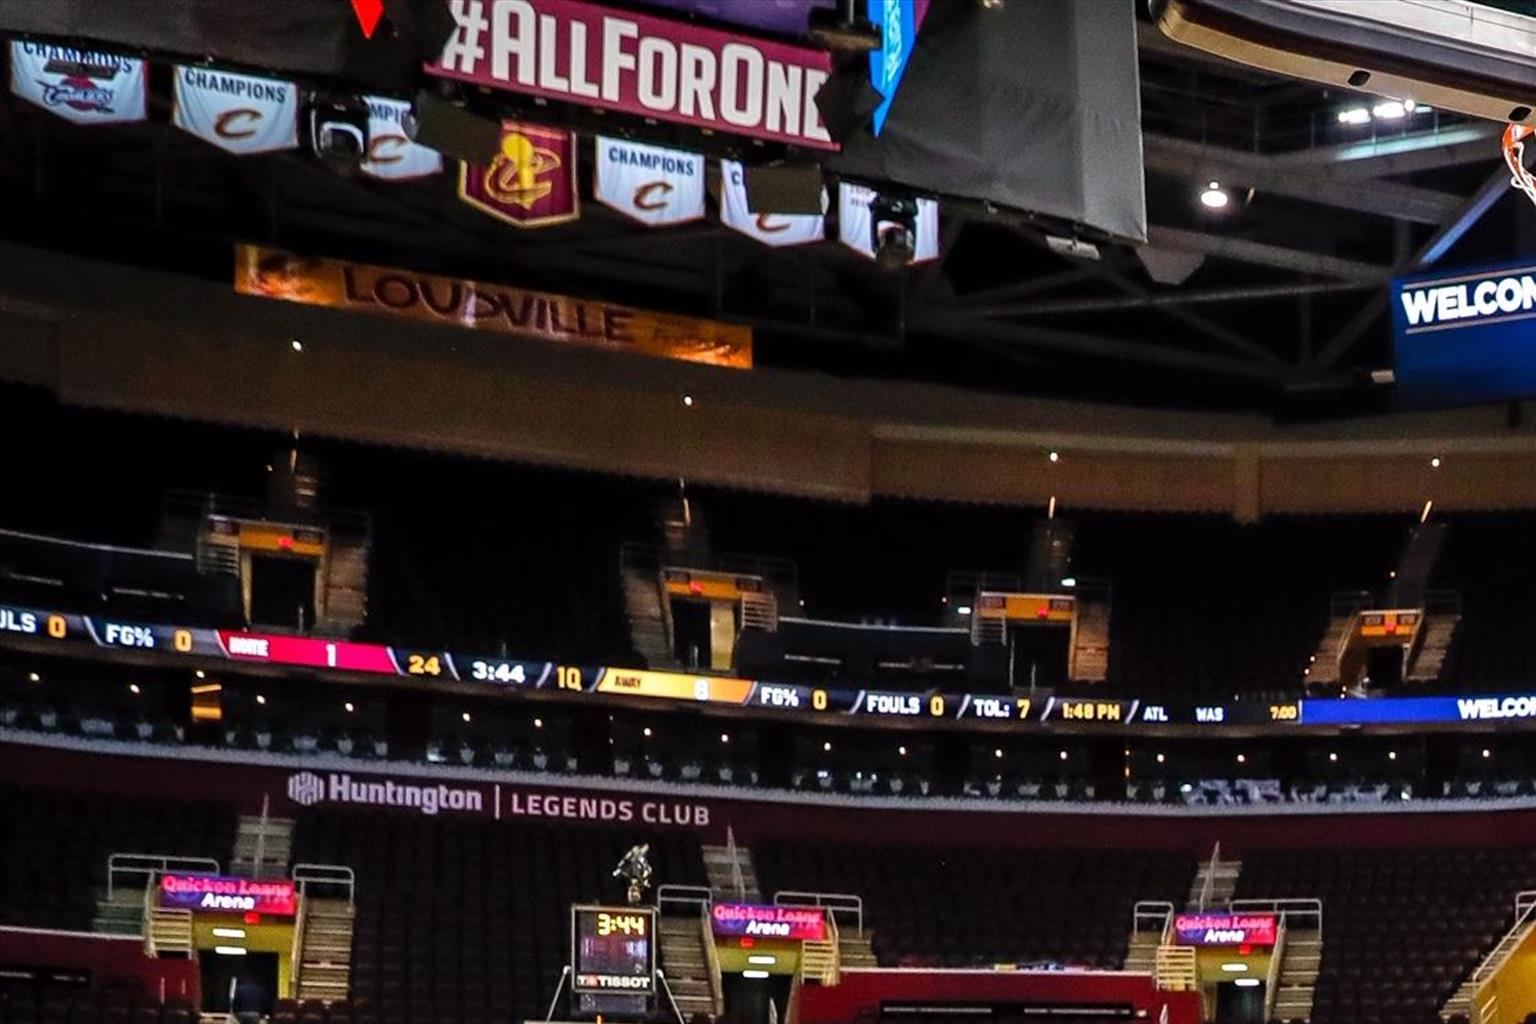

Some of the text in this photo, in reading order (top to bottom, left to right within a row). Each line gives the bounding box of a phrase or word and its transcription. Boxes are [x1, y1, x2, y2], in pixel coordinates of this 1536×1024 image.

[185, 68, 286, 103] CHAMPIONS
[608, 146, 695, 177] CHAMPIONS
[48, 615, 66, 639] 0
[106, 623, 192, 652] FG% 0
[408, 654, 441, 676] 24
[472, 661, 525, 684] 3:44
[557, 666, 582, 692] 1Q
[761, 686, 827, 710] FG% 0
[867, 694, 944, 716] FOULS 0
[1017, 699, 1031, 719] 7
[1096, 703, 1121, 721] PM
[1143, 706, 1168, 721] ATL
[329, 774, 710, 827] Huntington LEGENDS CLUB
[201, 892, 256, 909] Arena
[598, 913, 644, 936] 3:44
[746, 920, 790, 936] Arena
